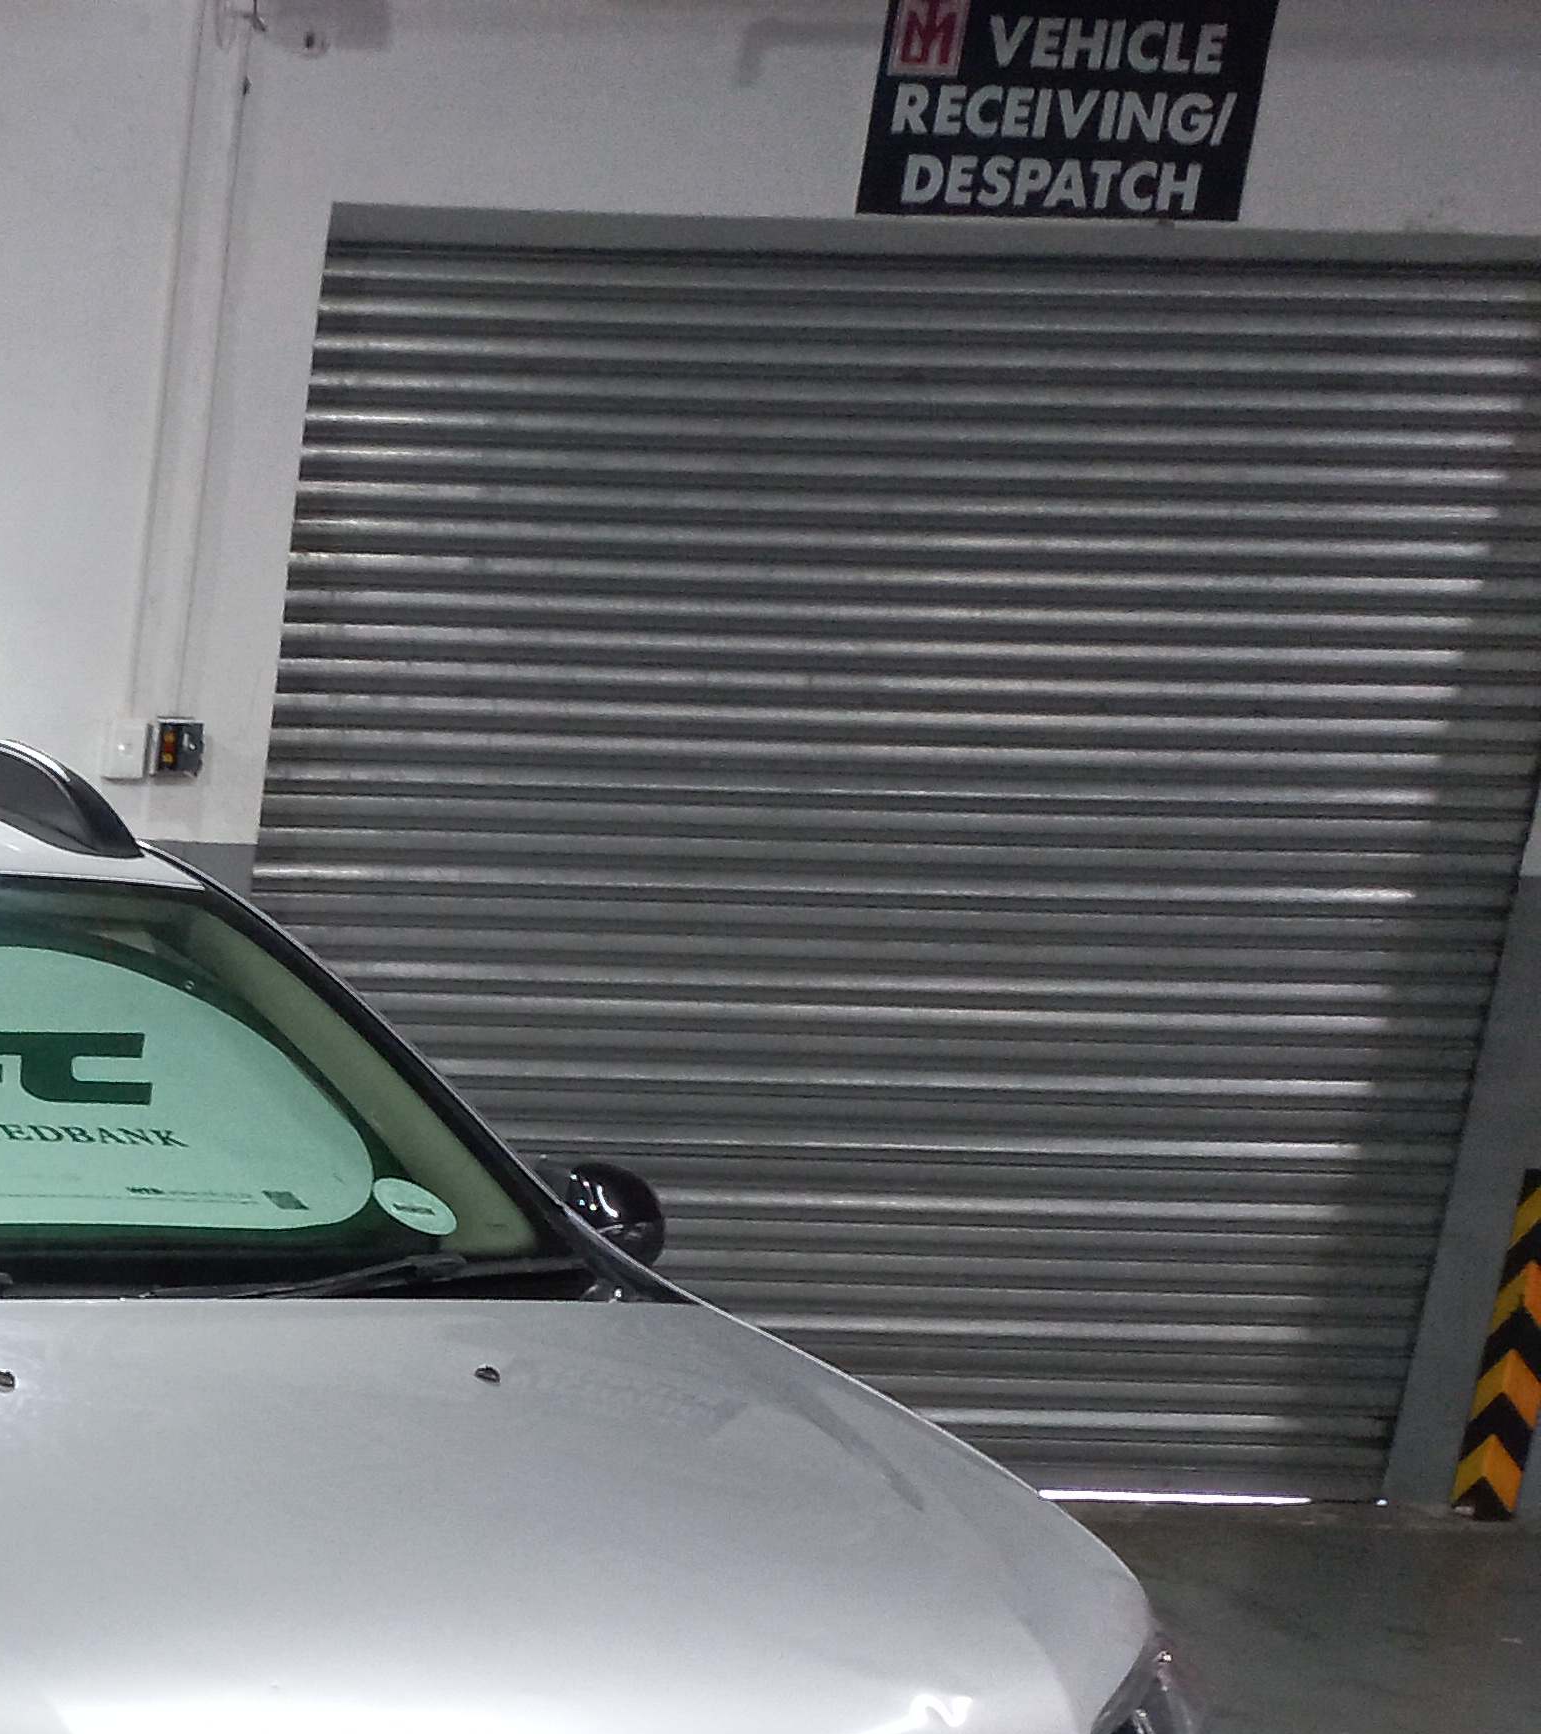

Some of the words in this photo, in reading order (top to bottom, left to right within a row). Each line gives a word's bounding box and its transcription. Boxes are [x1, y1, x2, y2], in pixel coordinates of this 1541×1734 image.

[990, 15, 1228, 75] VEHICLE
[891, 83, 1237, 146] RECEIVING/
[900, 153, 1202, 213] DESPATCH
